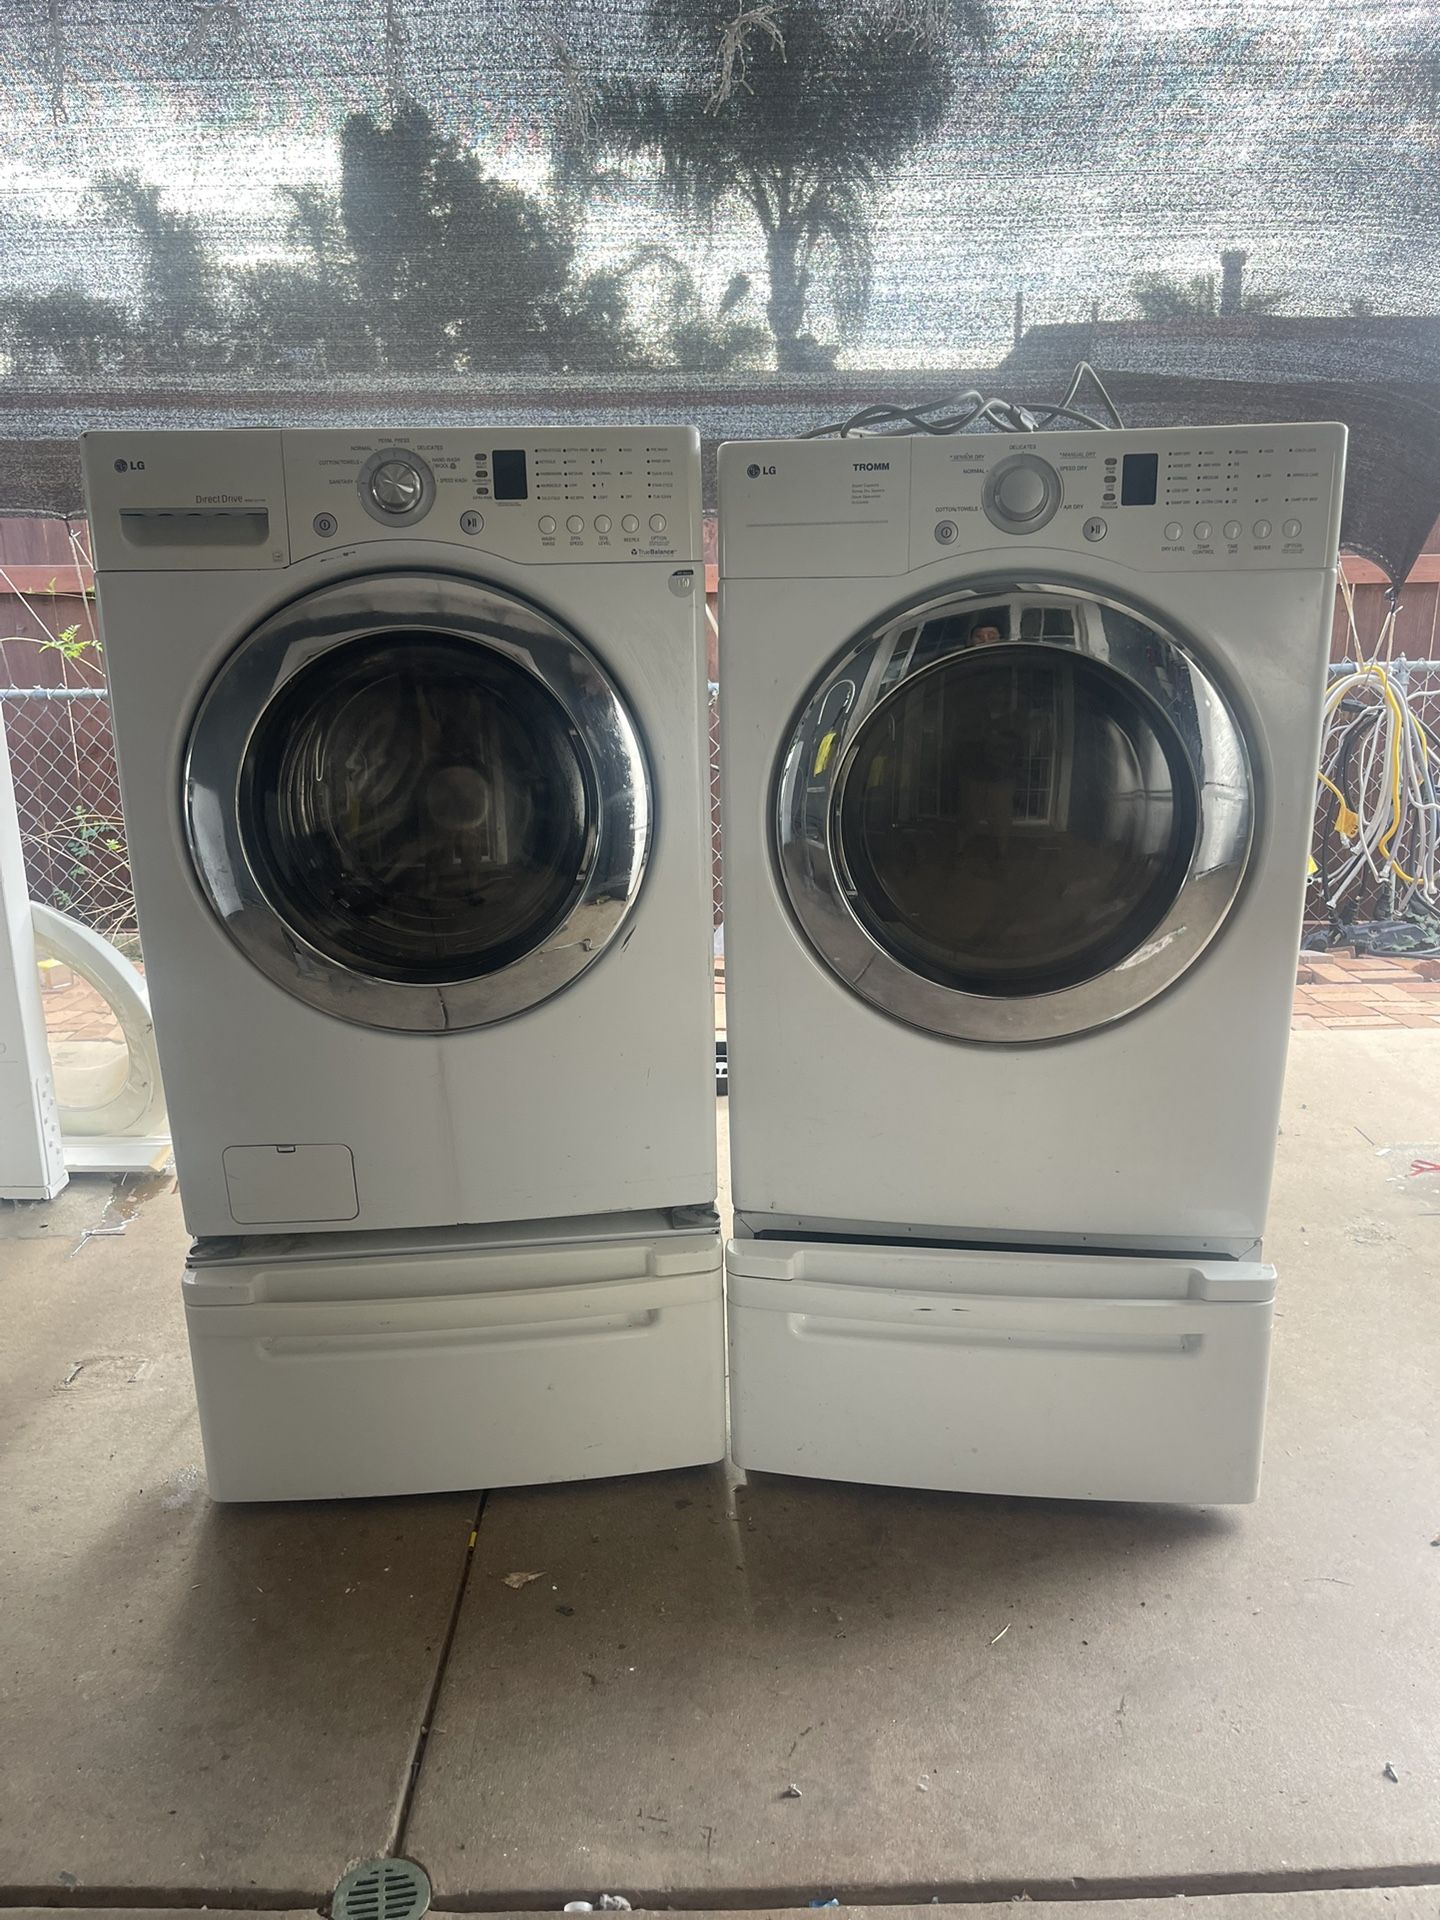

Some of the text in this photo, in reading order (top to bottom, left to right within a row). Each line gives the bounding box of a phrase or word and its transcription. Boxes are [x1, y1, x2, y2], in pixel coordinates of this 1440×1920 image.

[130, 461, 145, 470] LG
[852, 462, 890, 471] TROMM
[762, 466, 777, 475] LG
[195, 495, 220, 503] Direct
[221, 494, 243, 503] Drive
